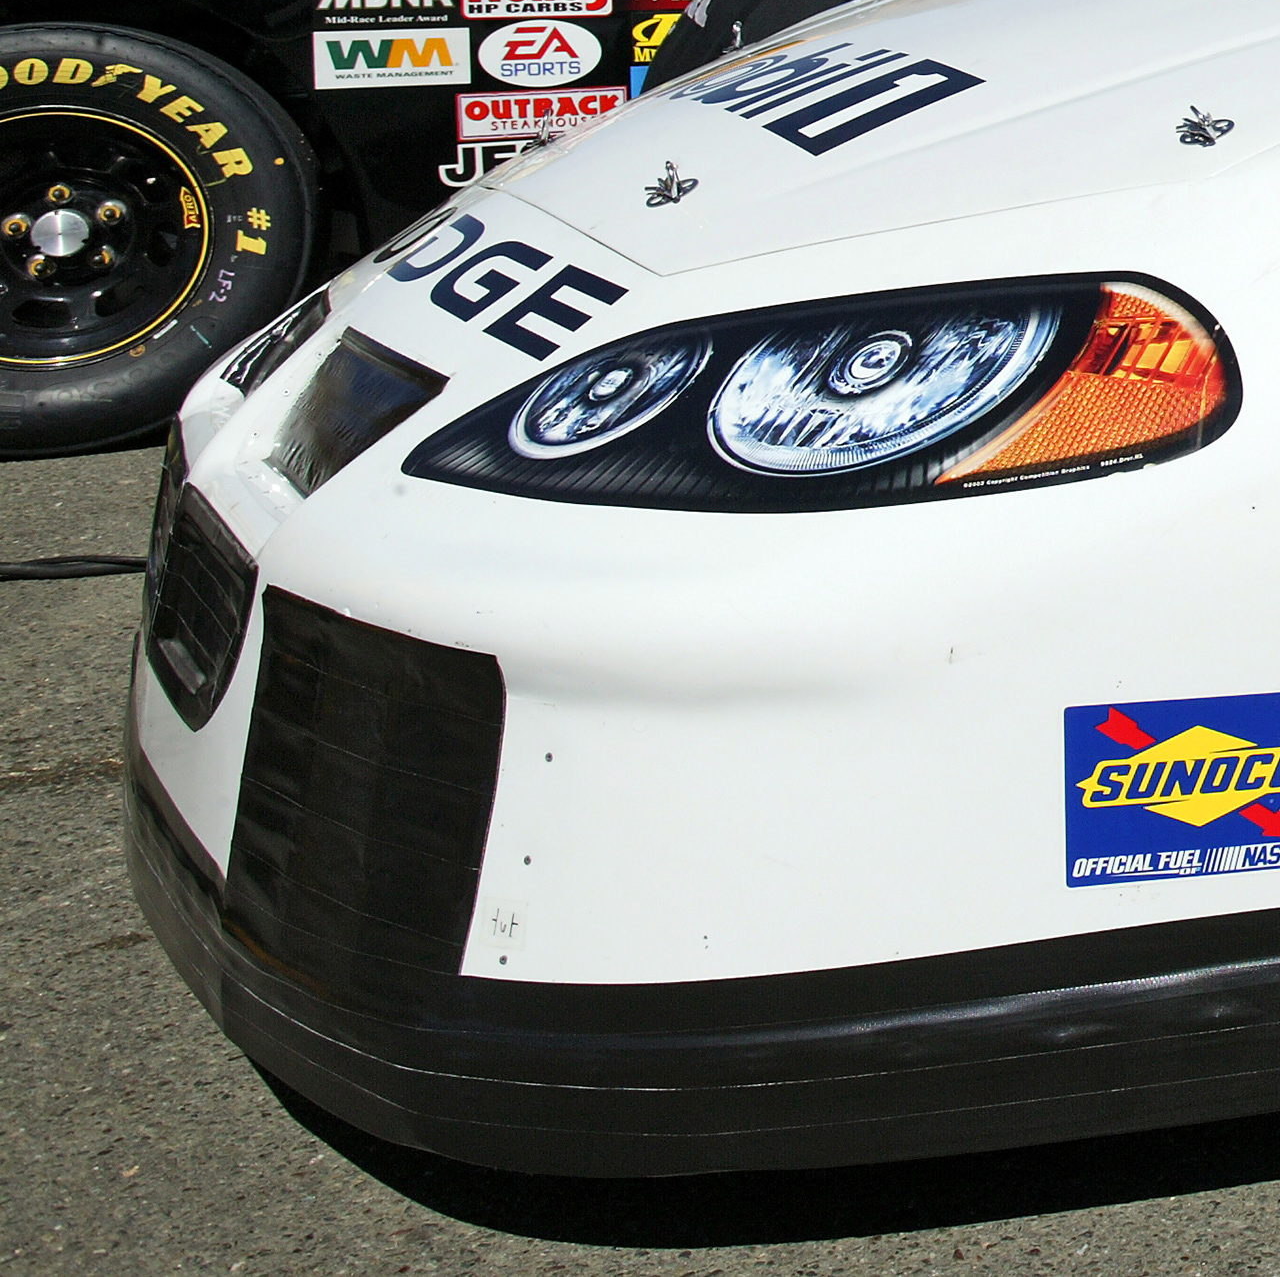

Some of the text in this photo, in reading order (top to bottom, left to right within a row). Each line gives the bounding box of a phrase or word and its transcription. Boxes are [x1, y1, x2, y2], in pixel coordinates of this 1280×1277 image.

[325, 13, 448, 24] Mid-Race Leader Award
[469, 1, 583, 14] HP CARBS
[326, 38, 453, 70] WM
[502, 26, 580, 61] EA
[376, 70, 454, 78] MANAGEMENT
[501, 61, 581, 78] SPORTS
[465, 94, 619, 120] OUTBACK
[234, 207, 271, 255] #1
[1072, 853, 1153, 878] OFFICIAL
[1157, 849, 1203, 871] FUEL
